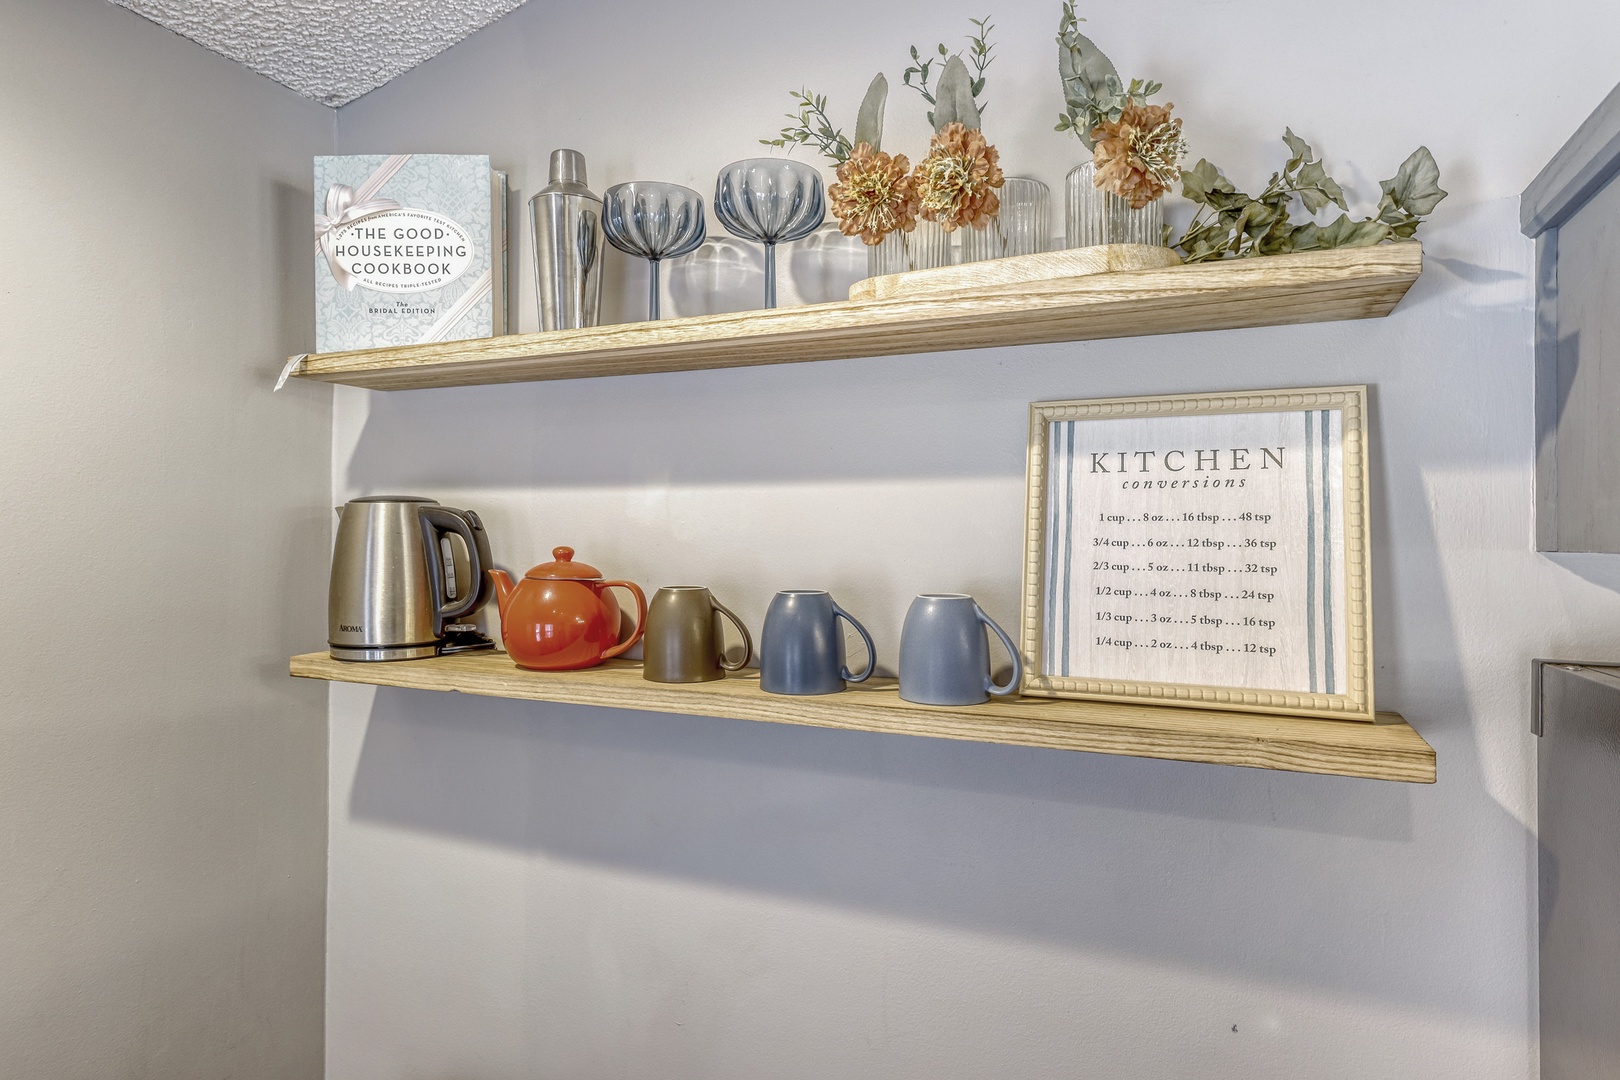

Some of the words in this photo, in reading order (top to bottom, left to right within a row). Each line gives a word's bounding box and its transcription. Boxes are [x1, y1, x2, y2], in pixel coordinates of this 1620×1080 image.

[354, 227, 387, 240] THE
[393, 227, 444, 240] GOOD
[407, 212, 432, 221] FAVORITE
[433, 217, 446, 226] TEST
[446, 224, 465, 242] KITCHEN
[335, 245, 467, 257] HOUSEKEEPING
[351, 262, 451, 275] COOKBOOK
[363, 277, 373, 285] ALL
[375, 280, 399, 289] RECIPES
[1089, 446, 1286, 474] KITCHEN
[1122, 475, 1247, 490] conversions
[1099, 512, 1105, 522] 1
[1142, 512, 1150, 522] 8
[1182, 512, 1195, 522] 16
[1196, 511, 1220, 525] tbsp
[1238, 511, 1253, 522] 48
[1254, 513, 1272, 525] tsp
[1092, 537, 1110, 547] 3/4
[1147, 537, 1154, 548] 6
[1187, 537, 1200, 548] 12
[1201, 537, 1225, 551] tbsp
[1243, 538, 1258, 548] 36
[1259, 540, 1277, 551] tsp
[1092, 560, 1110, 571] 2/3
[1147, 561, 1154, 572] 5
[1187, 562, 1200, 573] 11
[1201, 562, 1226, 576] tbsp
[1244, 563, 1259, 574] 32
[1260, 565, 1278, 577] tsp
[1095, 585, 1112, 596] 1/2
[1149, 587, 1157, 597] 4
[1190, 588, 1197, 598] 8
[1198, 588, 1222, 602] tbsp
[1241, 589, 1256, 600] 24
[1257, 591, 1275, 604] tsp
[339, 624, 363, 632] AROMA
[1095, 611, 1112, 622] 1/3
[1150, 613, 1158, 623] 3
[1190, 614, 1197, 625] 5
[1199, 614, 1223, 629] tbsp
[1242, 616, 1256, 627] 16
[1258, 618, 1276, 631] tsp
[1095, 636, 1112, 646] 1/4
[1150, 638, 1158, 649] 2
[1190, 640, 1198, 651] 4
[1199, 640, 1224, 655] tbsp
[1243, 643, 1257, 653] 12
[1258, 645, 1277, 658] tsp
